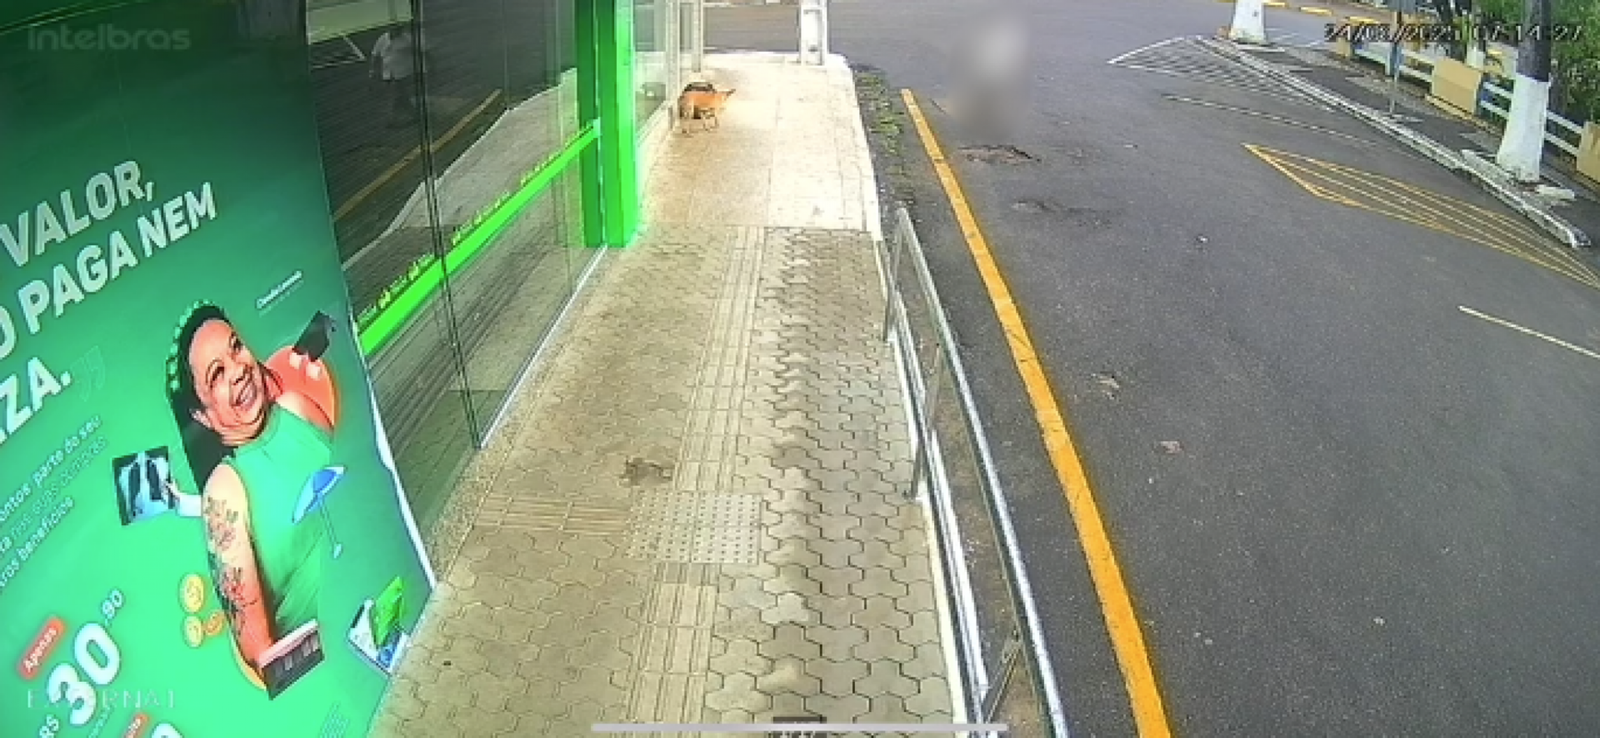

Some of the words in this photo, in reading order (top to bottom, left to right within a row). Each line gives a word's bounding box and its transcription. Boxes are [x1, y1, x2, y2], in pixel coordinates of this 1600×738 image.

[1, 160, 154, 267] VALOR,
[18, 230, 138, 334] PAGA
[137, 181, 217, 258] NEM
[0, 356, 72, 445] ZA.
[32, 449, 64, 488] parte
[65, 436, 81, 454] do
[79, 414, 103, 440] seu
[23, 626, 58, 674] Apenas
